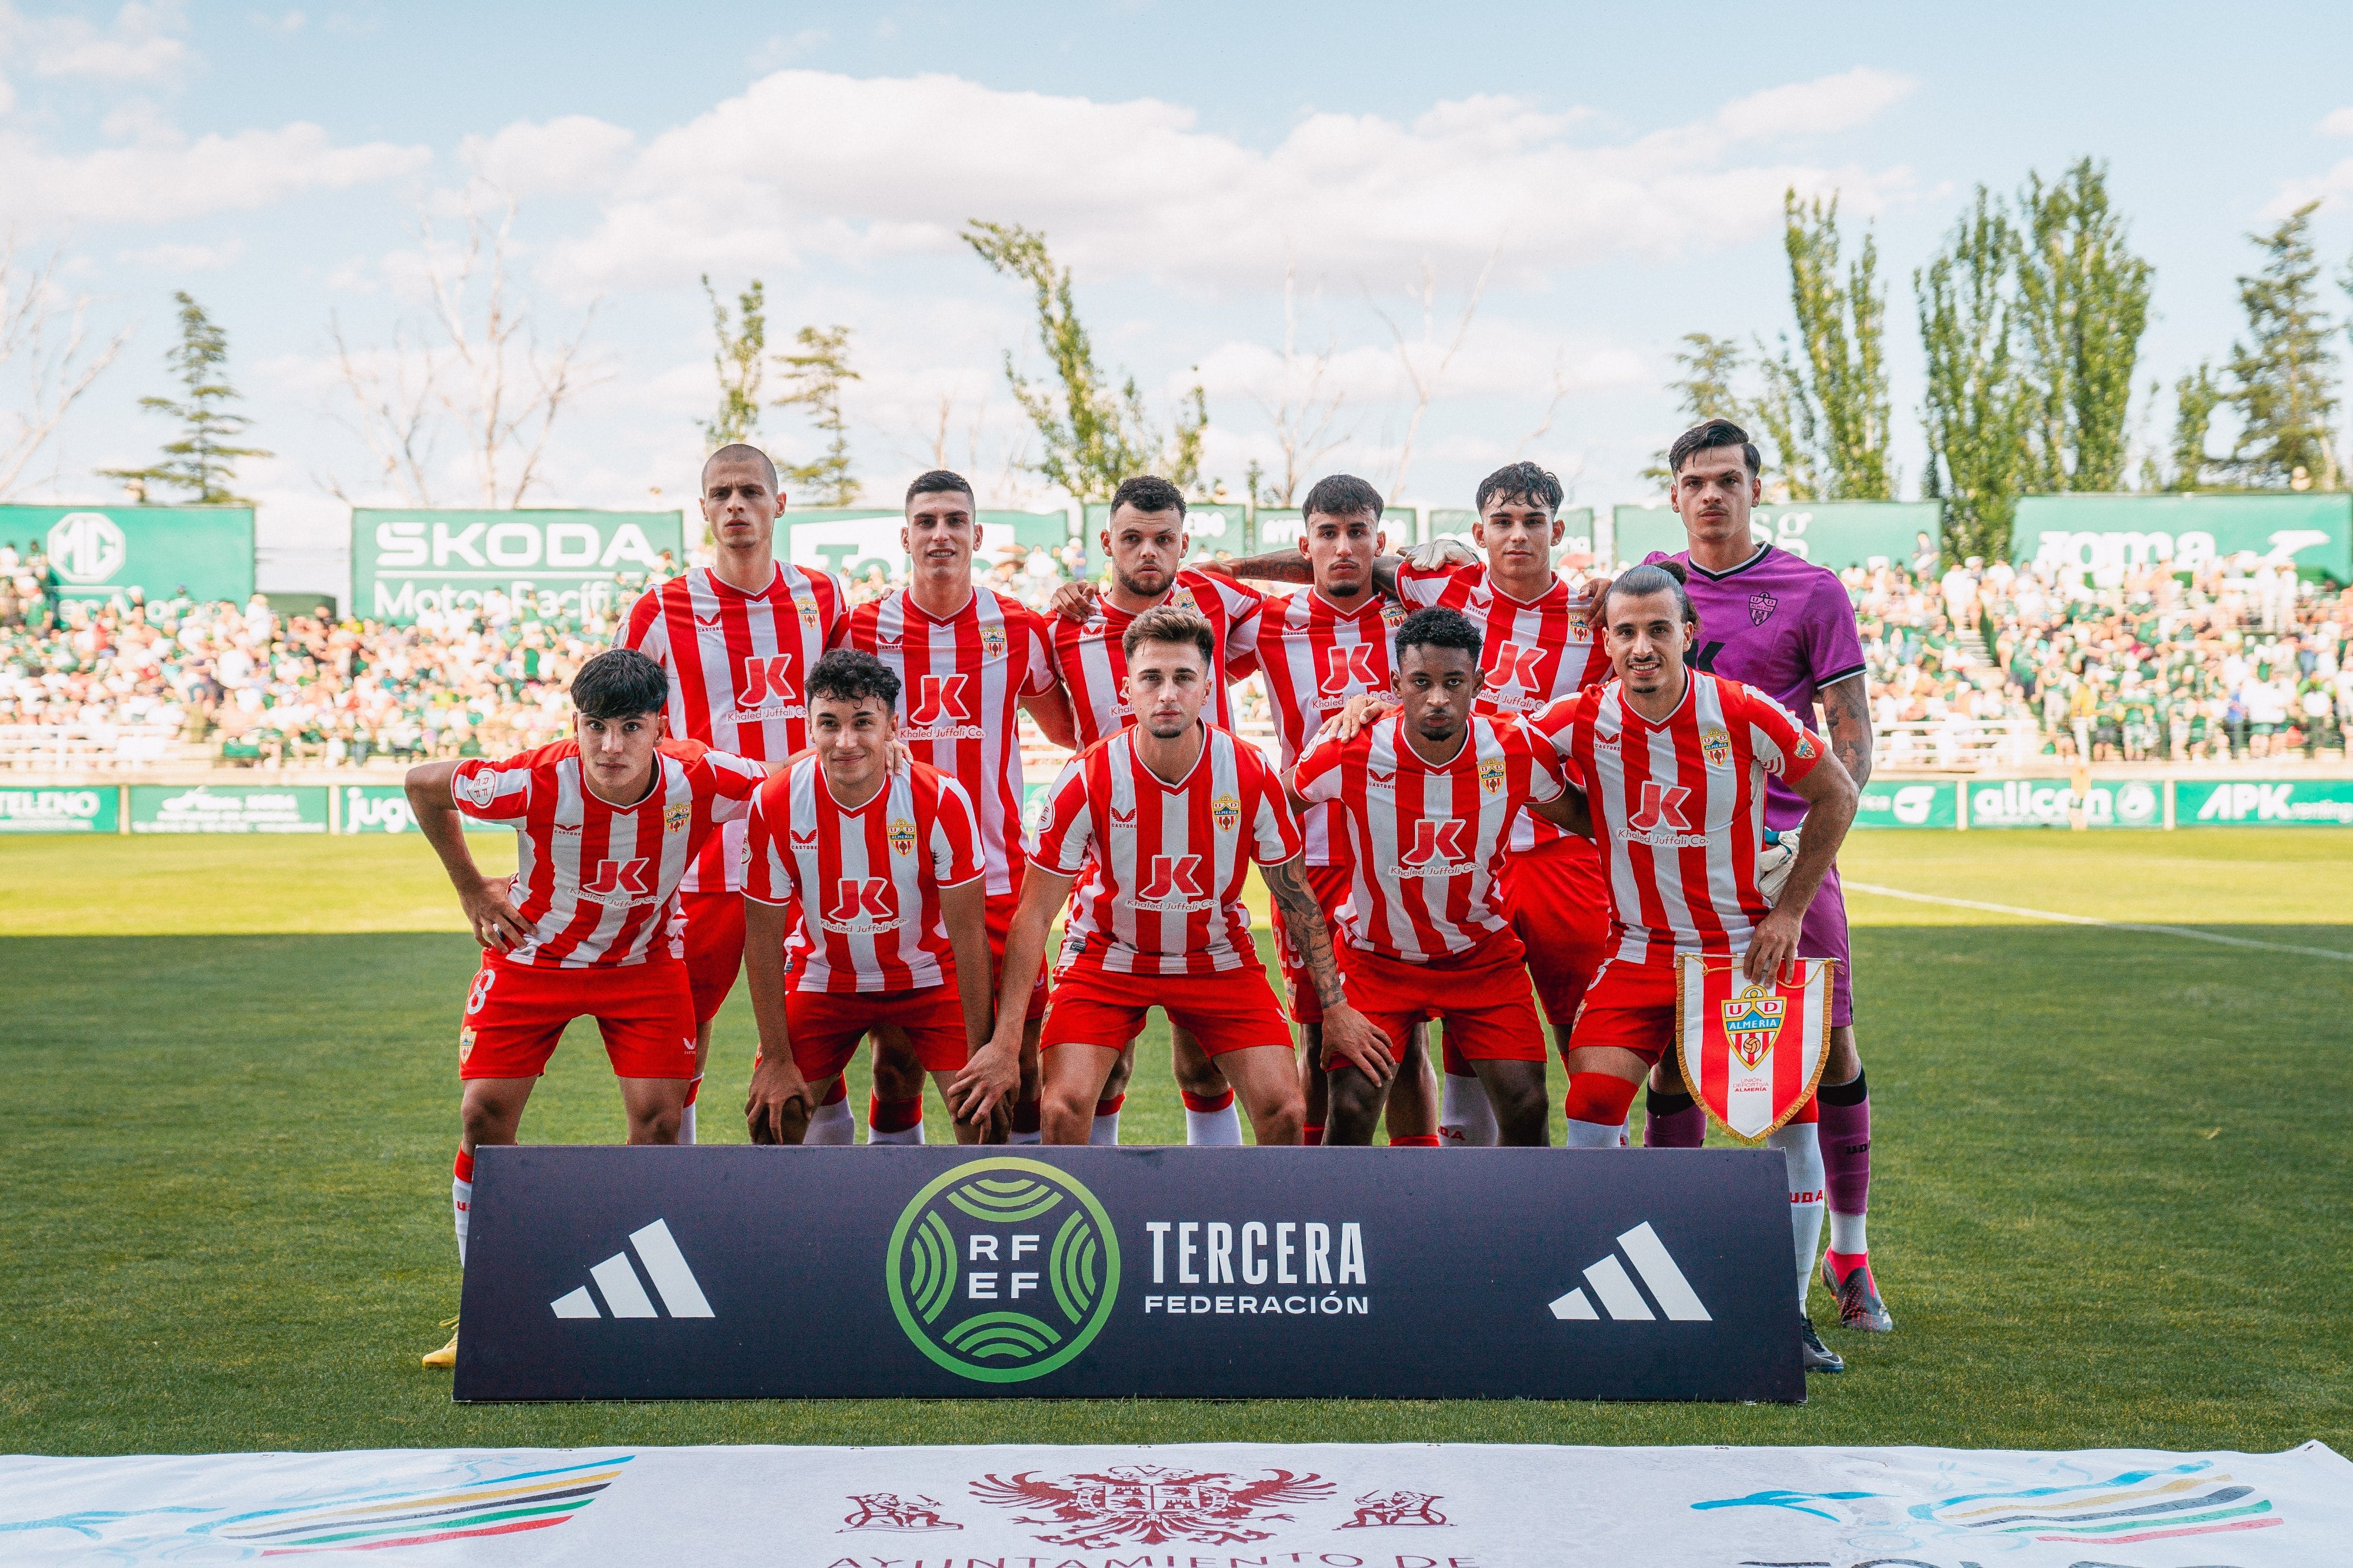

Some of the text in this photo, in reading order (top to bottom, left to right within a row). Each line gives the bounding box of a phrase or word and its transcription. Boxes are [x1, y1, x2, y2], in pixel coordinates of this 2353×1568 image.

[54, 518, 117, 576] MG
[1466, 605, 1487, 617] CASTORE
[1321, 643, 1379, 693] JK
[1486, 640, 1547, 692] JK
[738, 654, 796, 706] JK
[911, 674, 970, 725] JK
[1111, 704, 1135, 716] Khal
[1312, 697, 1344, 708] Khaled
[1502, 695, 1532, 708] Juffali
[728, 710, 761, 721] Khaled
[765, 708, 793, 718] Juffali
[900, 727, 984, 739] Khaled Juffali Co.
[1629, 781, 1691, 830] JK
[668, 814, 688, 822] ALMERIA
[1402, 819, 1465, 864] JK
[1618, 829, 1708, 845] Khaled Juffali Co.
[583, 858, 649, 895] JK
[1139, 855, 1203, 899] JK
[1391, 863, 1479, 877] Khaled Juffali Co.
[570, 887, 605, 902] Khaled
[609, 897, 641, 908] Juffali
[828, 878, 893, 920] JK
[1127, 899, 1217, 911] Khaled Juffali Co.
[820, 918, 907, 933] Khaled Juffali Co.
[466, 969, 496, 1015] 8
[1730, 1002, 1778, 1015] U D
[1147, 1222, 1367, 1285] TERCERA
[1145, 1290, 1368, 1315] FEDERACIÓN
